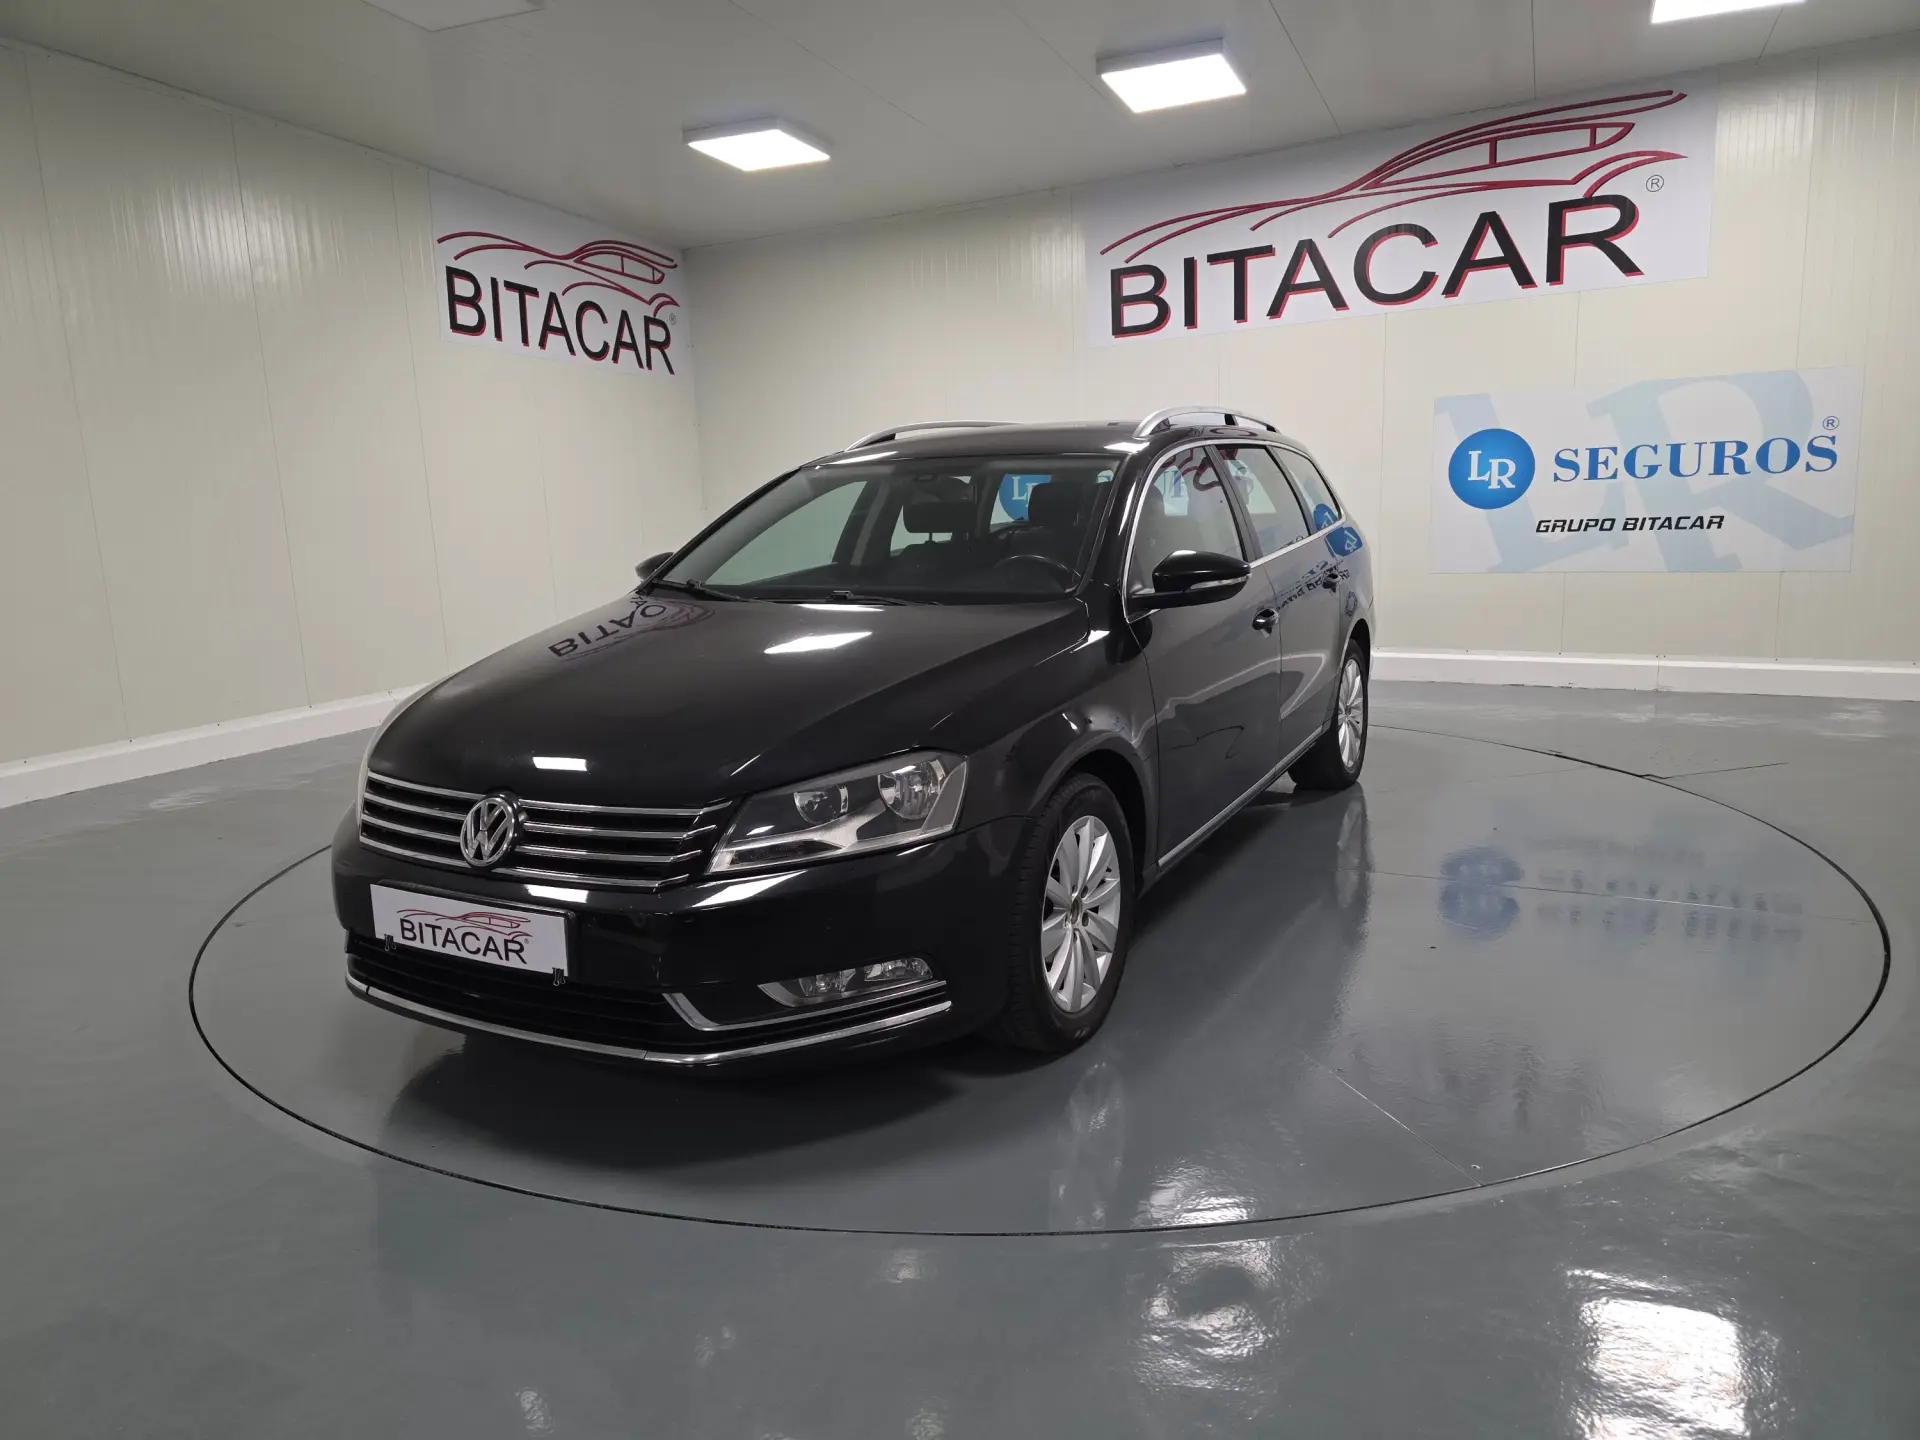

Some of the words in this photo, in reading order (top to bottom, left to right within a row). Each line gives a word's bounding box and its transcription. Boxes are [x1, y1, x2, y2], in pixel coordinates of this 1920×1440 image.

[1110, 194, 1644, 339] BITACAR
[446, 265, 675, 375] BITACAR
[1467, 450, 1517, 490] LR
[1552, 435, 1838, 483] SEGUROS
[1535, 517, 1616, 534] GRUPO
[1622, 515, 1725, 532] BITACAR
[400, 918, 528, 965] BITACAR
